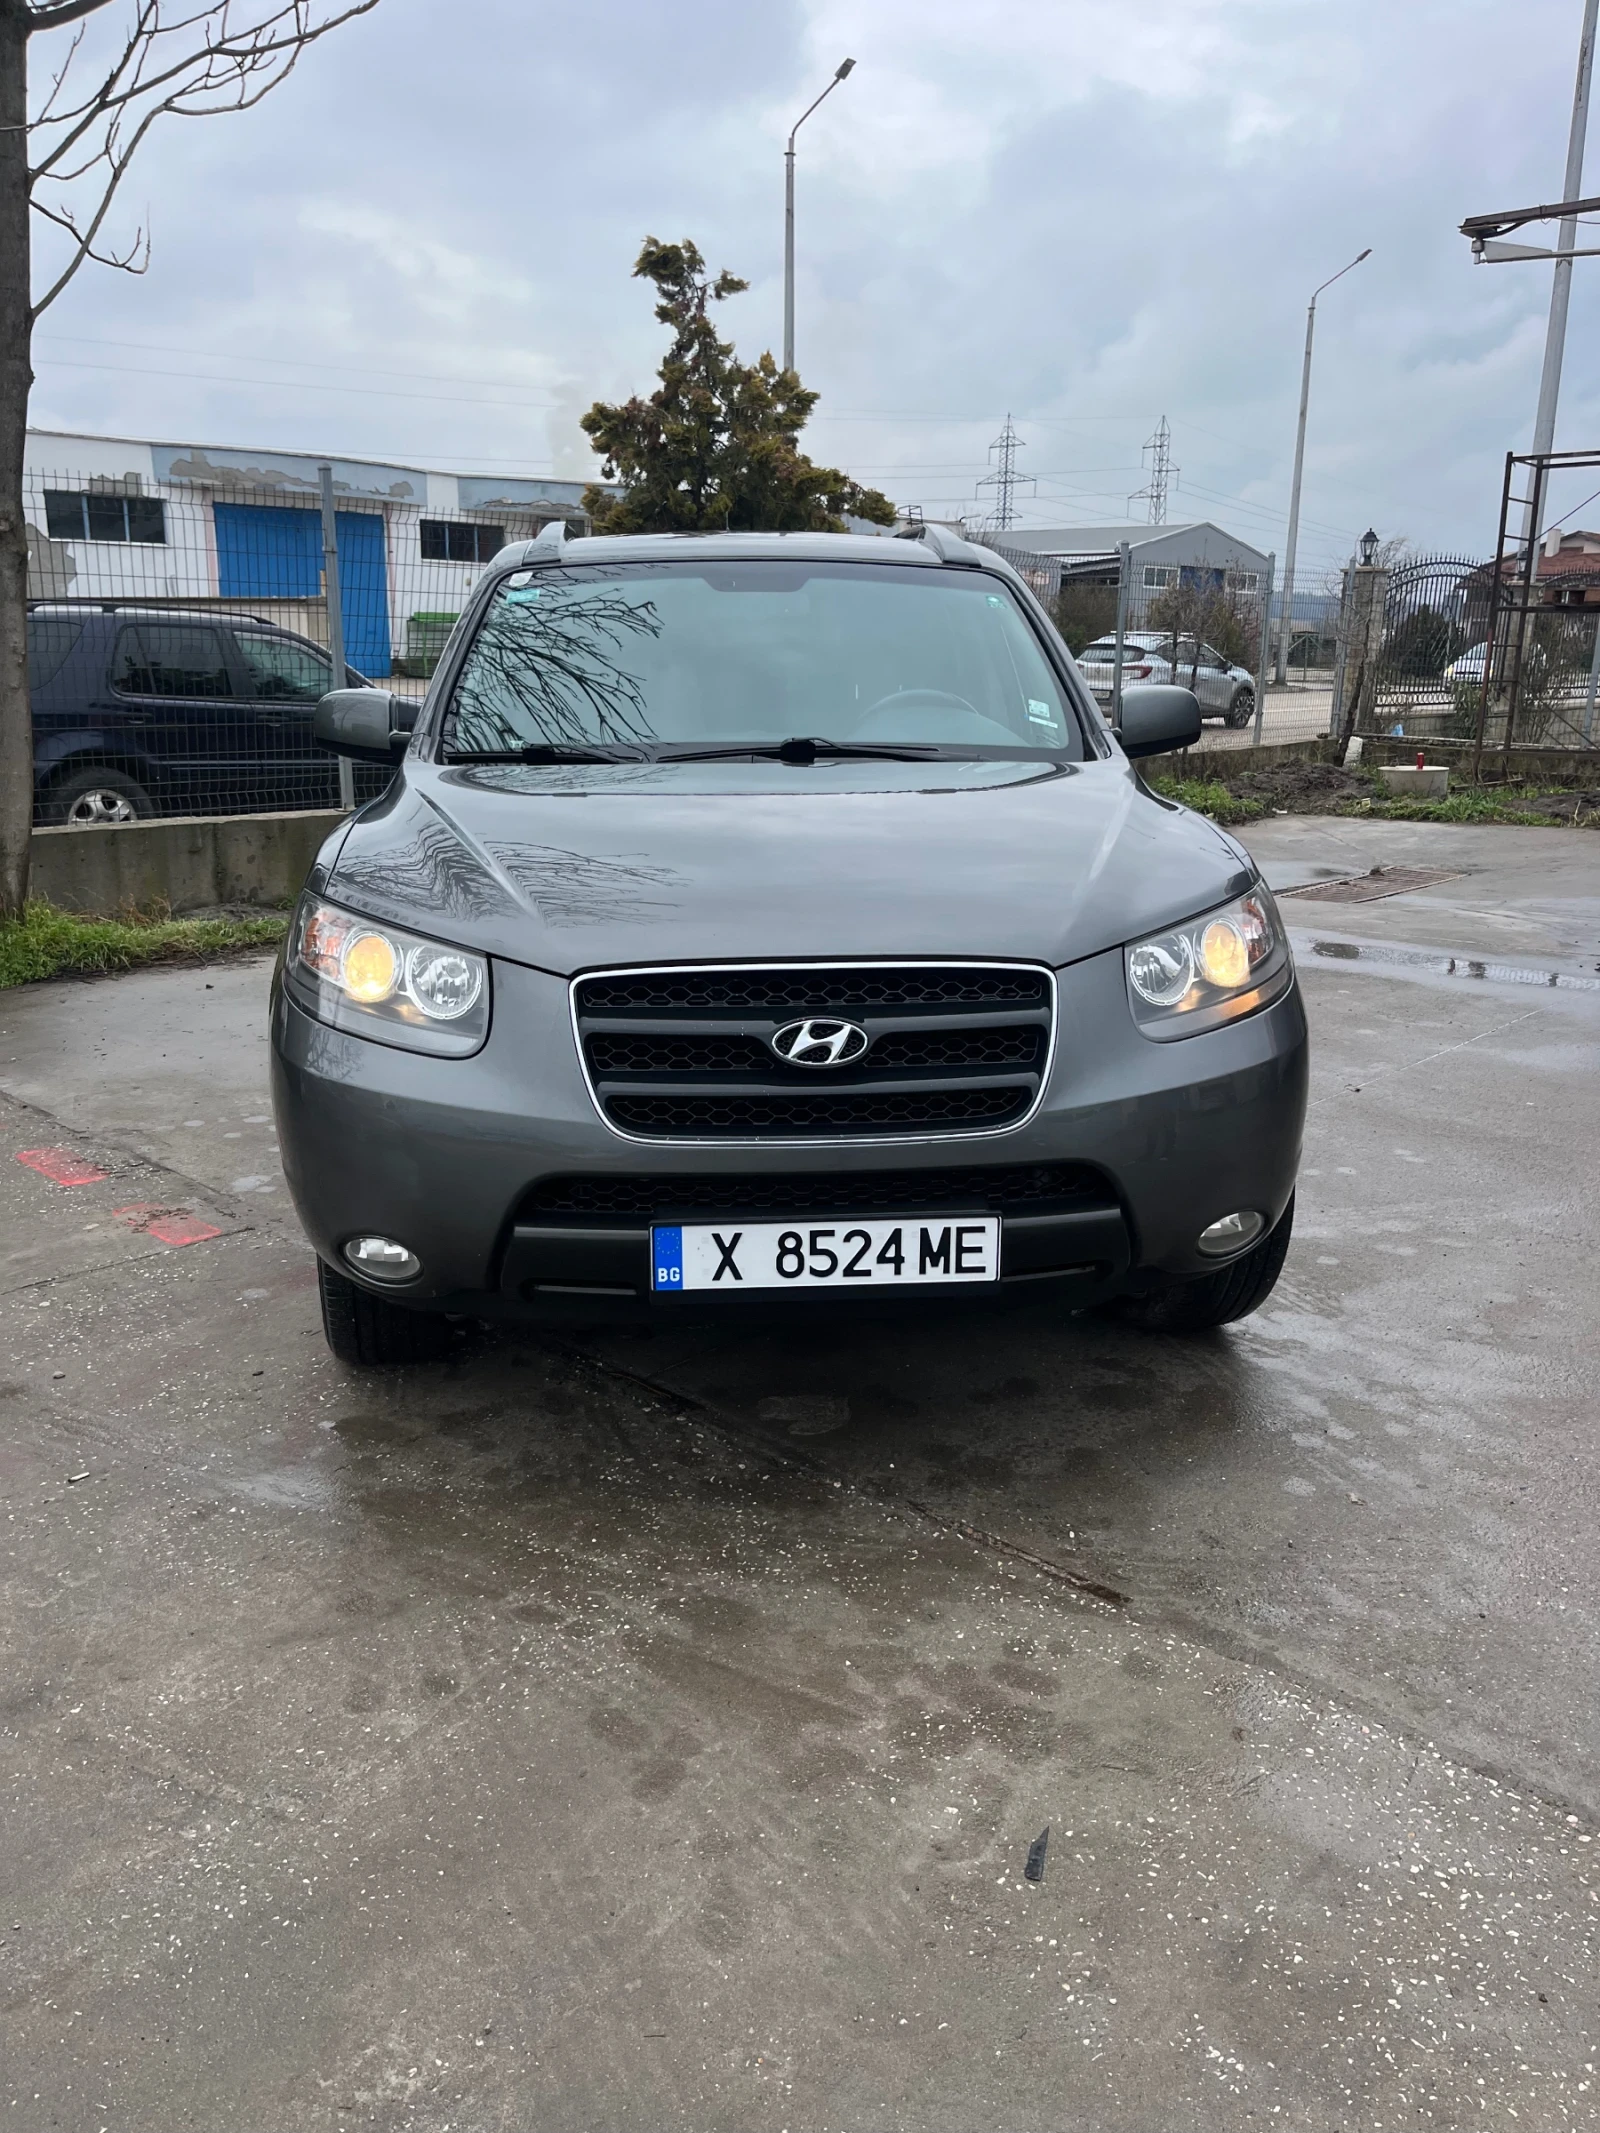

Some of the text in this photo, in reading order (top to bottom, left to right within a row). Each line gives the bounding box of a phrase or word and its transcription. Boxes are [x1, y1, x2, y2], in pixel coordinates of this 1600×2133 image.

[711, 1226, 987, 1281] X 8524 ME
[657, 1267, 680, 1283] BG
